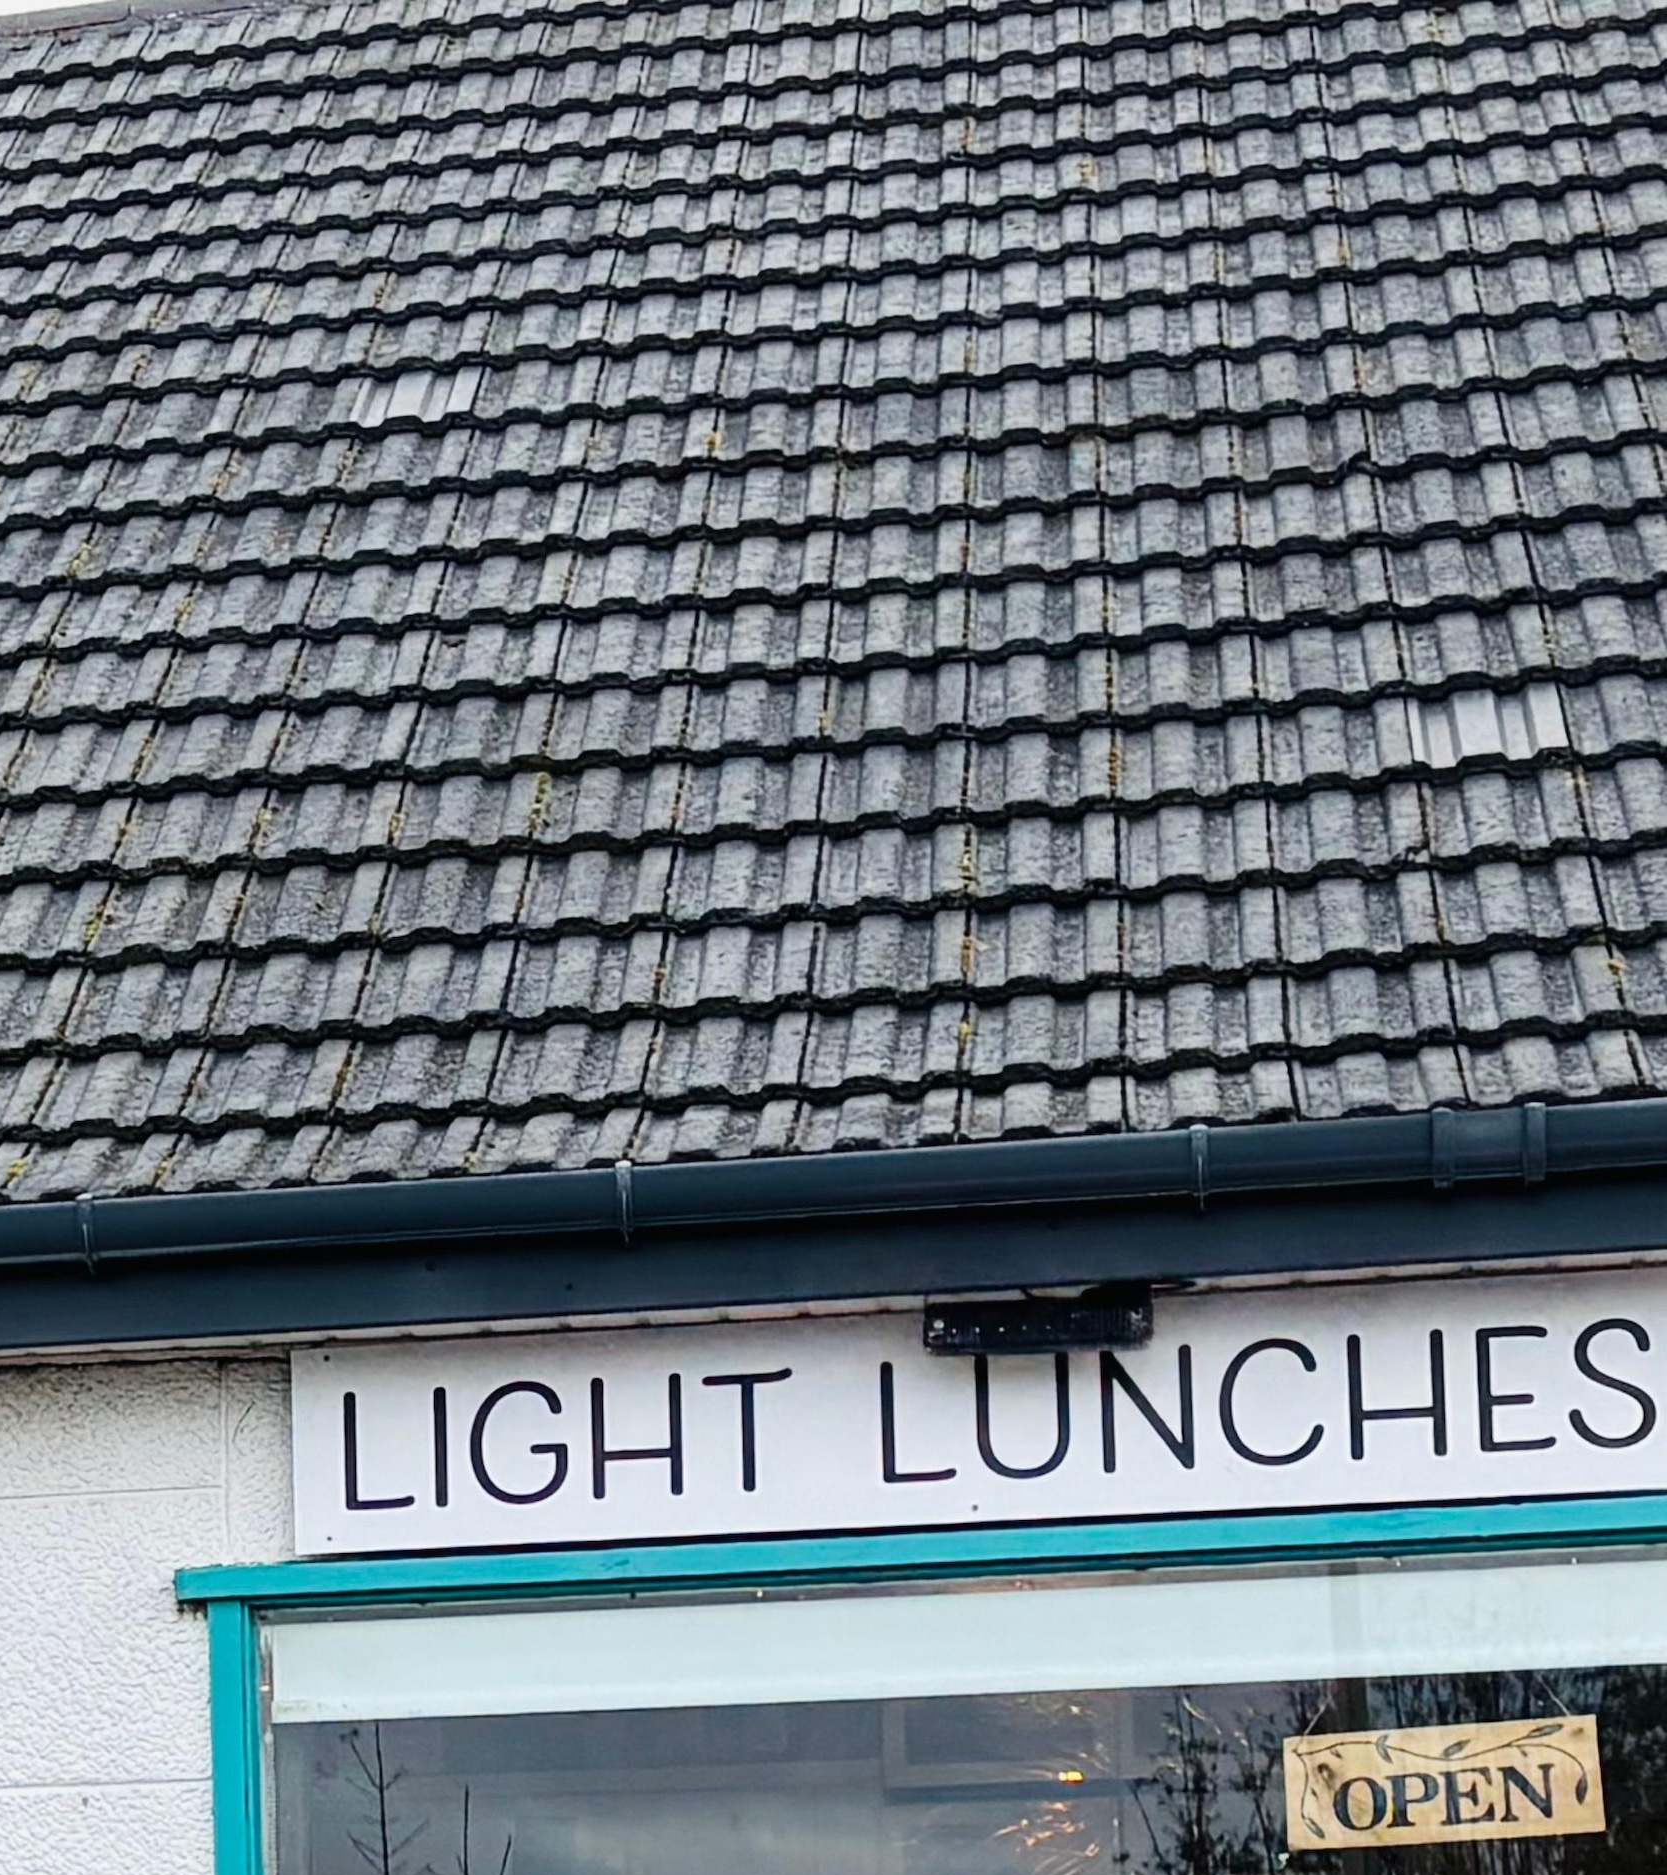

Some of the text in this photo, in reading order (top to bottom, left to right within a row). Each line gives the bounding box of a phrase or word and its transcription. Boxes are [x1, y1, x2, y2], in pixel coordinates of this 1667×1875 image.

[343, 1317, 1660, 1511] LIGHT LUNCHES
[1332, 1762, 1559, 1833] OPEN
